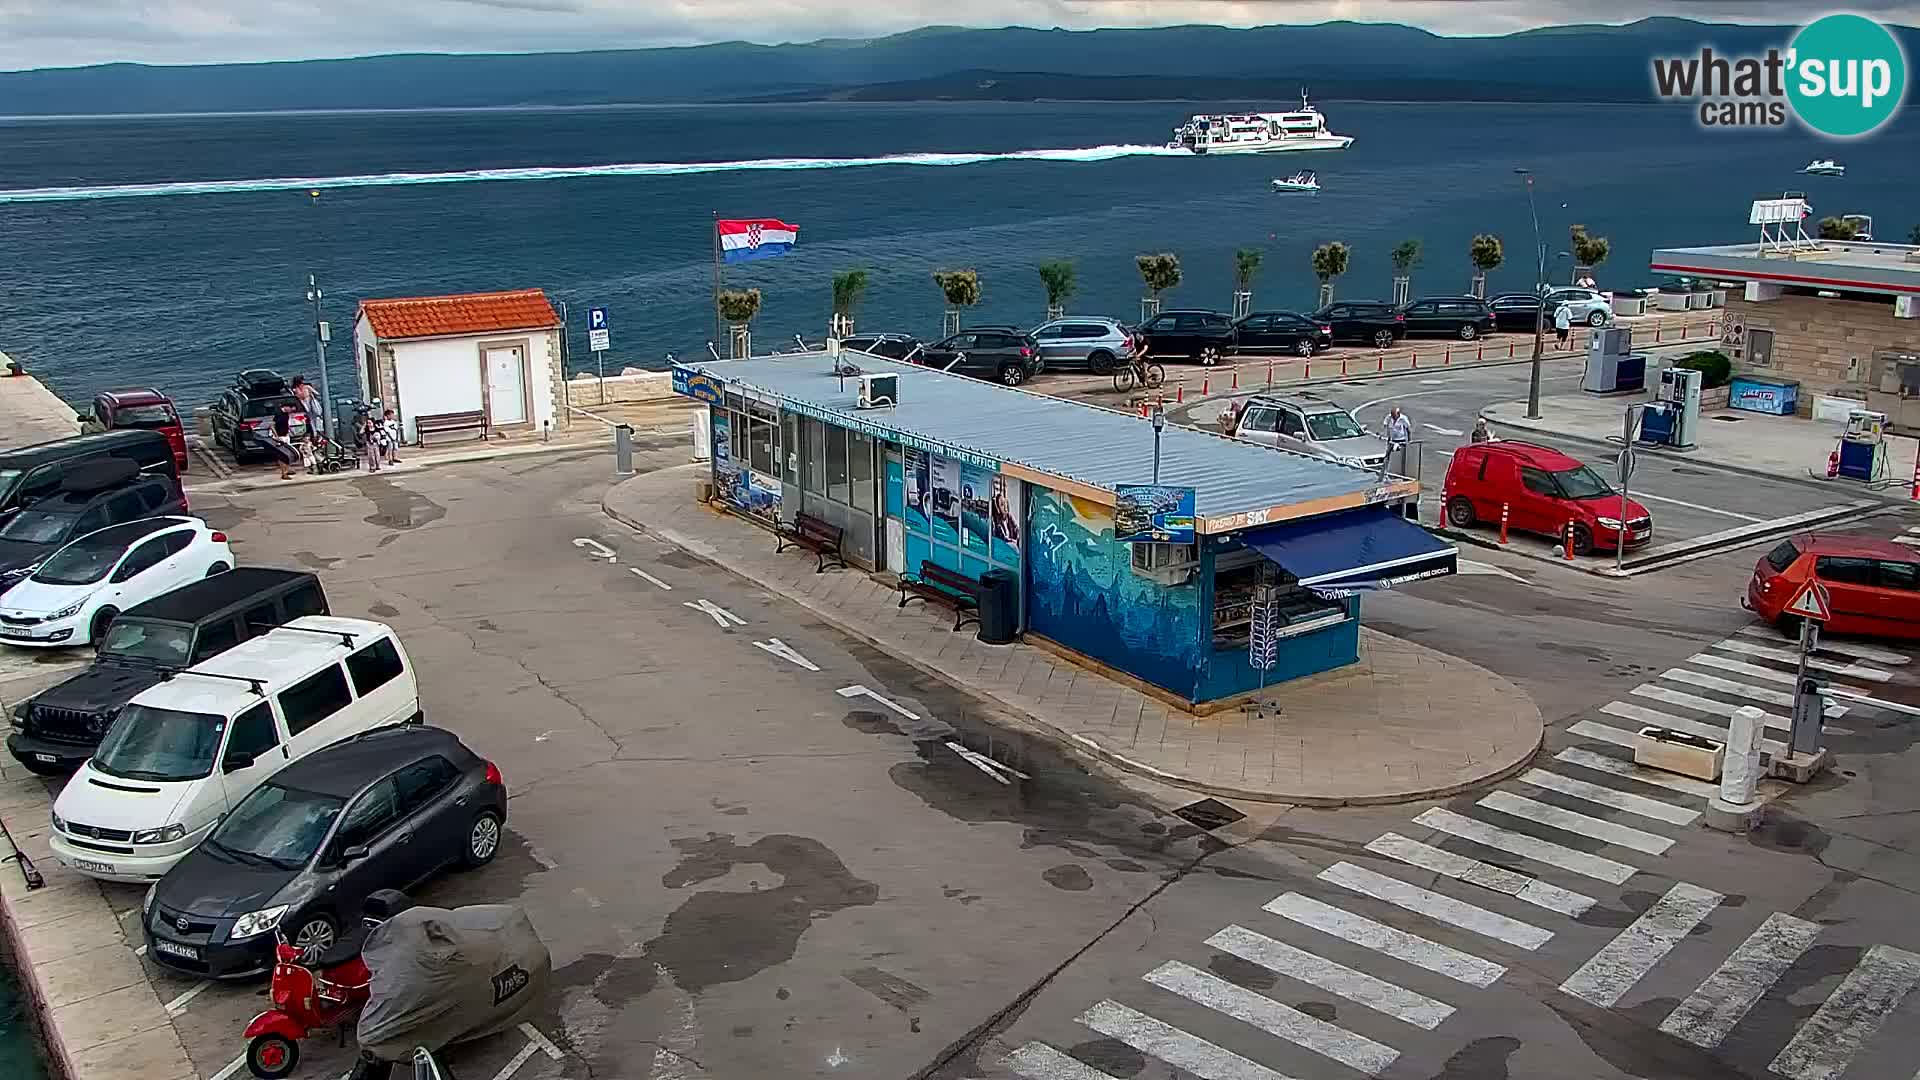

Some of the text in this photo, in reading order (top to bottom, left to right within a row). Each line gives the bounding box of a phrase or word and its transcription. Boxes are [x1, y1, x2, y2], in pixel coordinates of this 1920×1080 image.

[592, 310, 604, 328] P
[824, 411, 860, 431] AUTOBUSNA
[860, 422, 890, 441] POSTAJA
[900, 434, 913, 447] BUS
[913, 439, 944, 456] STATION
[946, 448, 971, 463] TICKET
[971, 455, 997, 470] OFFICE
